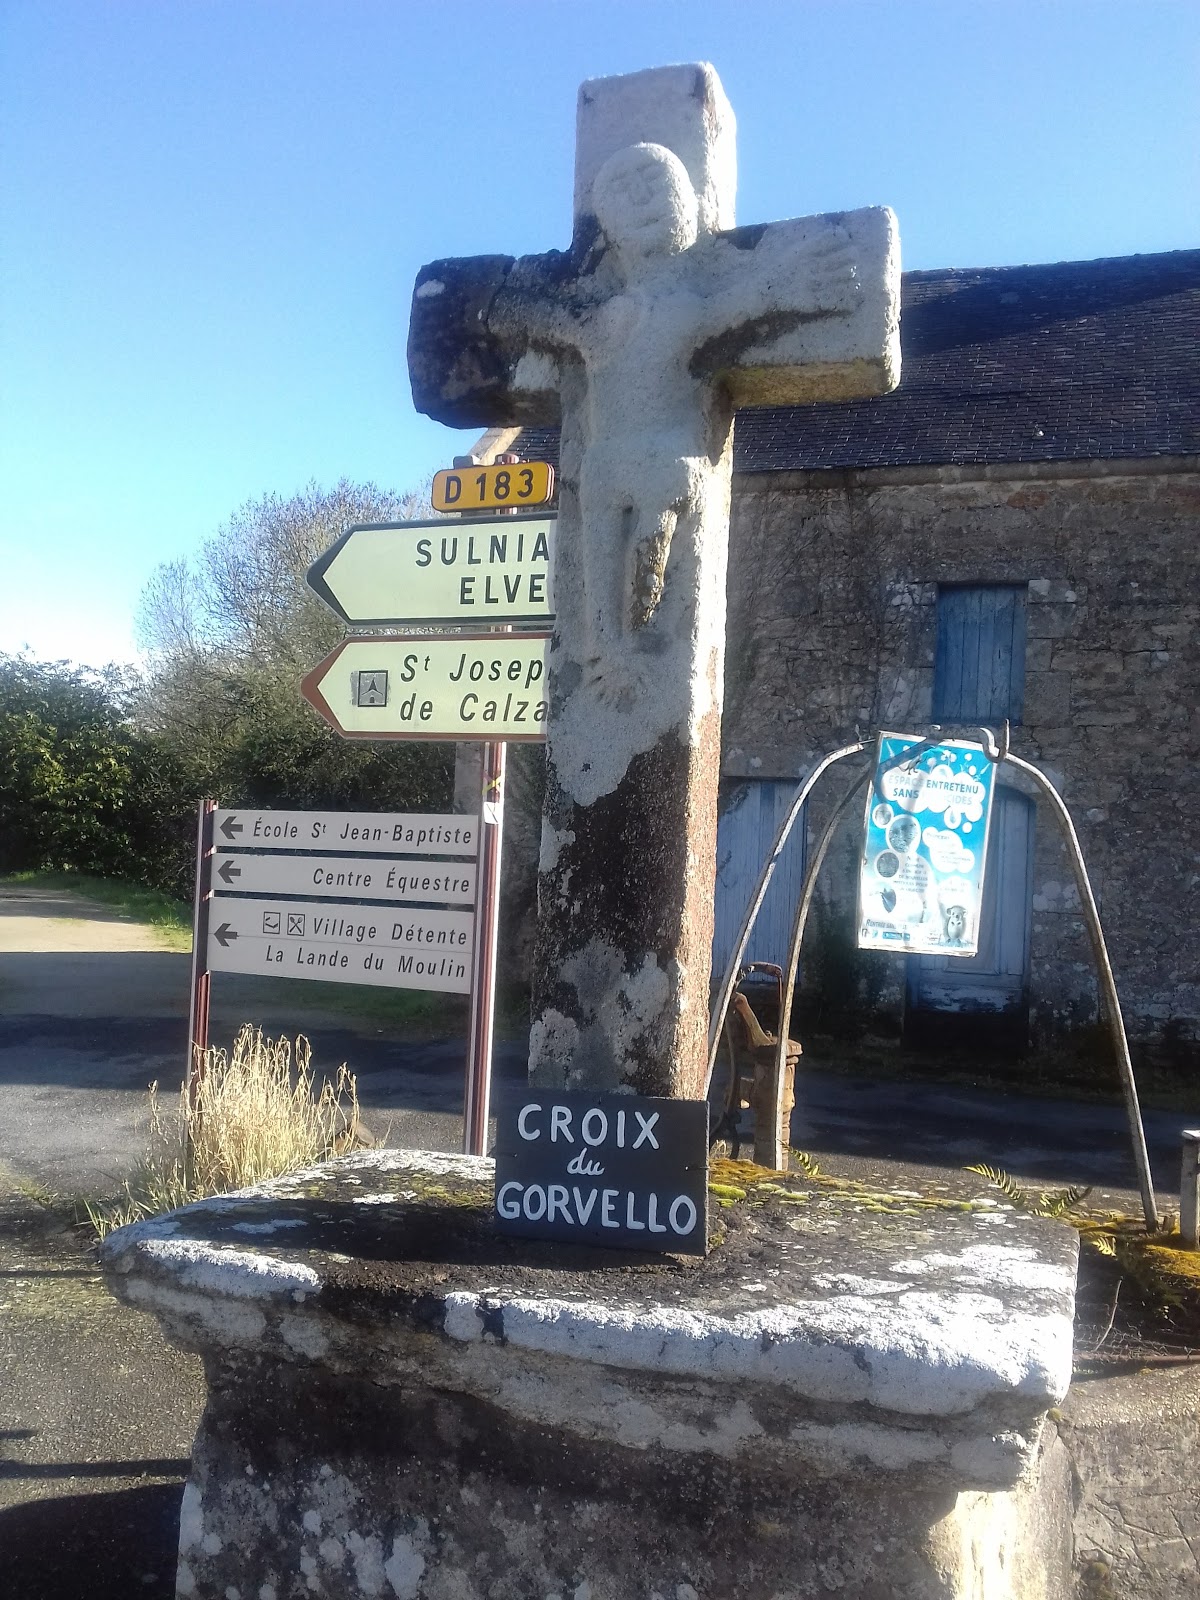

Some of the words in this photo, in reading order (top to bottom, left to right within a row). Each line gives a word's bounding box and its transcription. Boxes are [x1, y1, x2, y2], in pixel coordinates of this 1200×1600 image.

[444, 475, 462, 503] D
[476, 469, 534, 501] 183
[415, 532, 550, 567] SULNIA
[460, 574, 546, 604] ELVE
[400, 654, 431, 682] St
[450, 653, 544, 689] Josep
[400, 693, 433, 721] de
[459, 692, 549, 722] Calza
[893, 787, 920, 799] SANS
[926, 779, 979, 794] ENTRETENU
[253, 816, 298, 839] École
[311, 821, 327, 839] St
[340, 822, 472, 847] Jean-Baptiste
[313, 868, 372, 888] Centre
[386, 867, 470, 893] Équestre
[313, 917, 377, 942] Village
[391, 923, 467, 946] Détente
[266, 945, 284, 963] La
[297, 947, 349, 968] Lande
[364, 952, 384, 971] du
[398, 954, 466, 979] Moulin
[517, 1103, 660, 1150] CROIX
[566, 1147, 605, 1176] du
[497, 1181, 697, 1236] GORVELLO
